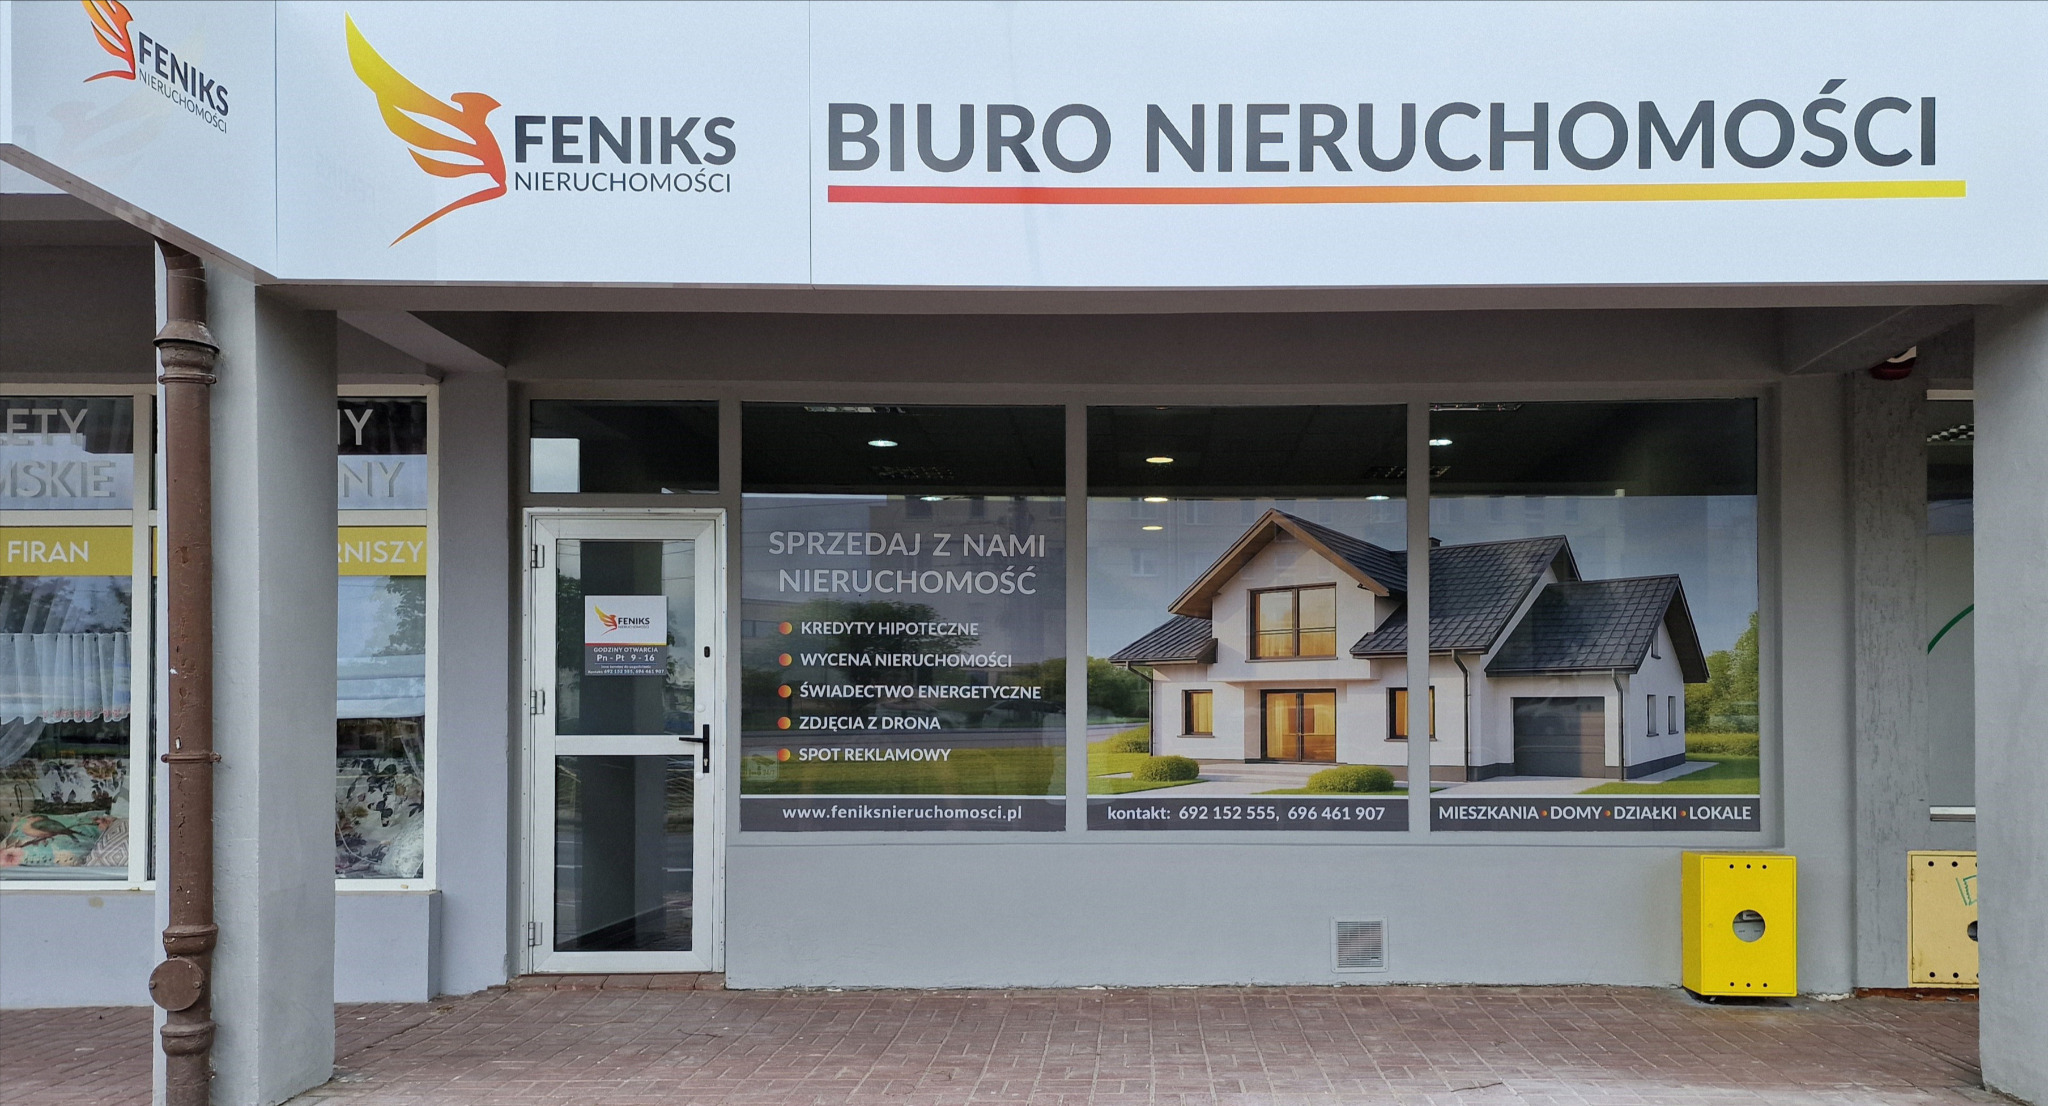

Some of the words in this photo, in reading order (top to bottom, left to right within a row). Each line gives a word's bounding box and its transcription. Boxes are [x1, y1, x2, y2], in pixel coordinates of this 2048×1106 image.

[139, 31, 228, 116] FENIKS
[139, 68, 226, 133] NIERUCHOMOŚCI
[828, 101, 1112, 175] BIURO
[1147, 79, 1936, 174] NIERUCHOMOŚCI
[514, 115, 737, 165] FENIKS
[514, 169, 732, 193] NIERUCHOMOŚCI
[0, 408, 89, 446] ETY
[7, 541, 88, 563] FIRAN
[769, 531, 921, 556] SPRZEDAJ
[933, 533, 951, 556] Z
[963, 534, 1045, 557] NAMI
[779, 566, 1036, 595] NIERUCHOMOŚĆ
[618, 617, 650, 625] FENIKS
[801, 622, 875, 635] KREDYTY
[879, 622, 979, 636] HIPOTECZNE
[801, 653, 871, 667] WYCENA
[875, 651, 1012, 668] NIERUCHOMOŚCI
[800, 682, 914, 699] ŚWIADECTWO
[918, 685, 1041, 699] ENERGETYCZNE
[799, 716, 863, 732] ZDJĘCIA
[868, 717, 878, 730] Z
[882, 717, 941, 730] DRONA
[799, 748, 841, 761] SPOT
[845, 748, 951, 762] REKLAMOWY
[782, 805, 1022, 821] www.feniksnieruchomosci.pl
[1107, 806, 1170, 820] kontakt:
[1179, 806, 1208, 820] 692
[1213, 806, 1242, 820] 152
[1246, 806, 1280, 822] 555,
[1288, 806, 1317, 820] 696
[1321, 807, 1351, 820] 461
[1355, 807, 1385, 821] 907
[1439, 805, 1539, 820] MIESZKANIA
[1550, 806, 1602, 820] DOMY
[1614, 806, 1676, 820] DZIAŁKI
[1689, 806, 1751, 820] LOKALE
